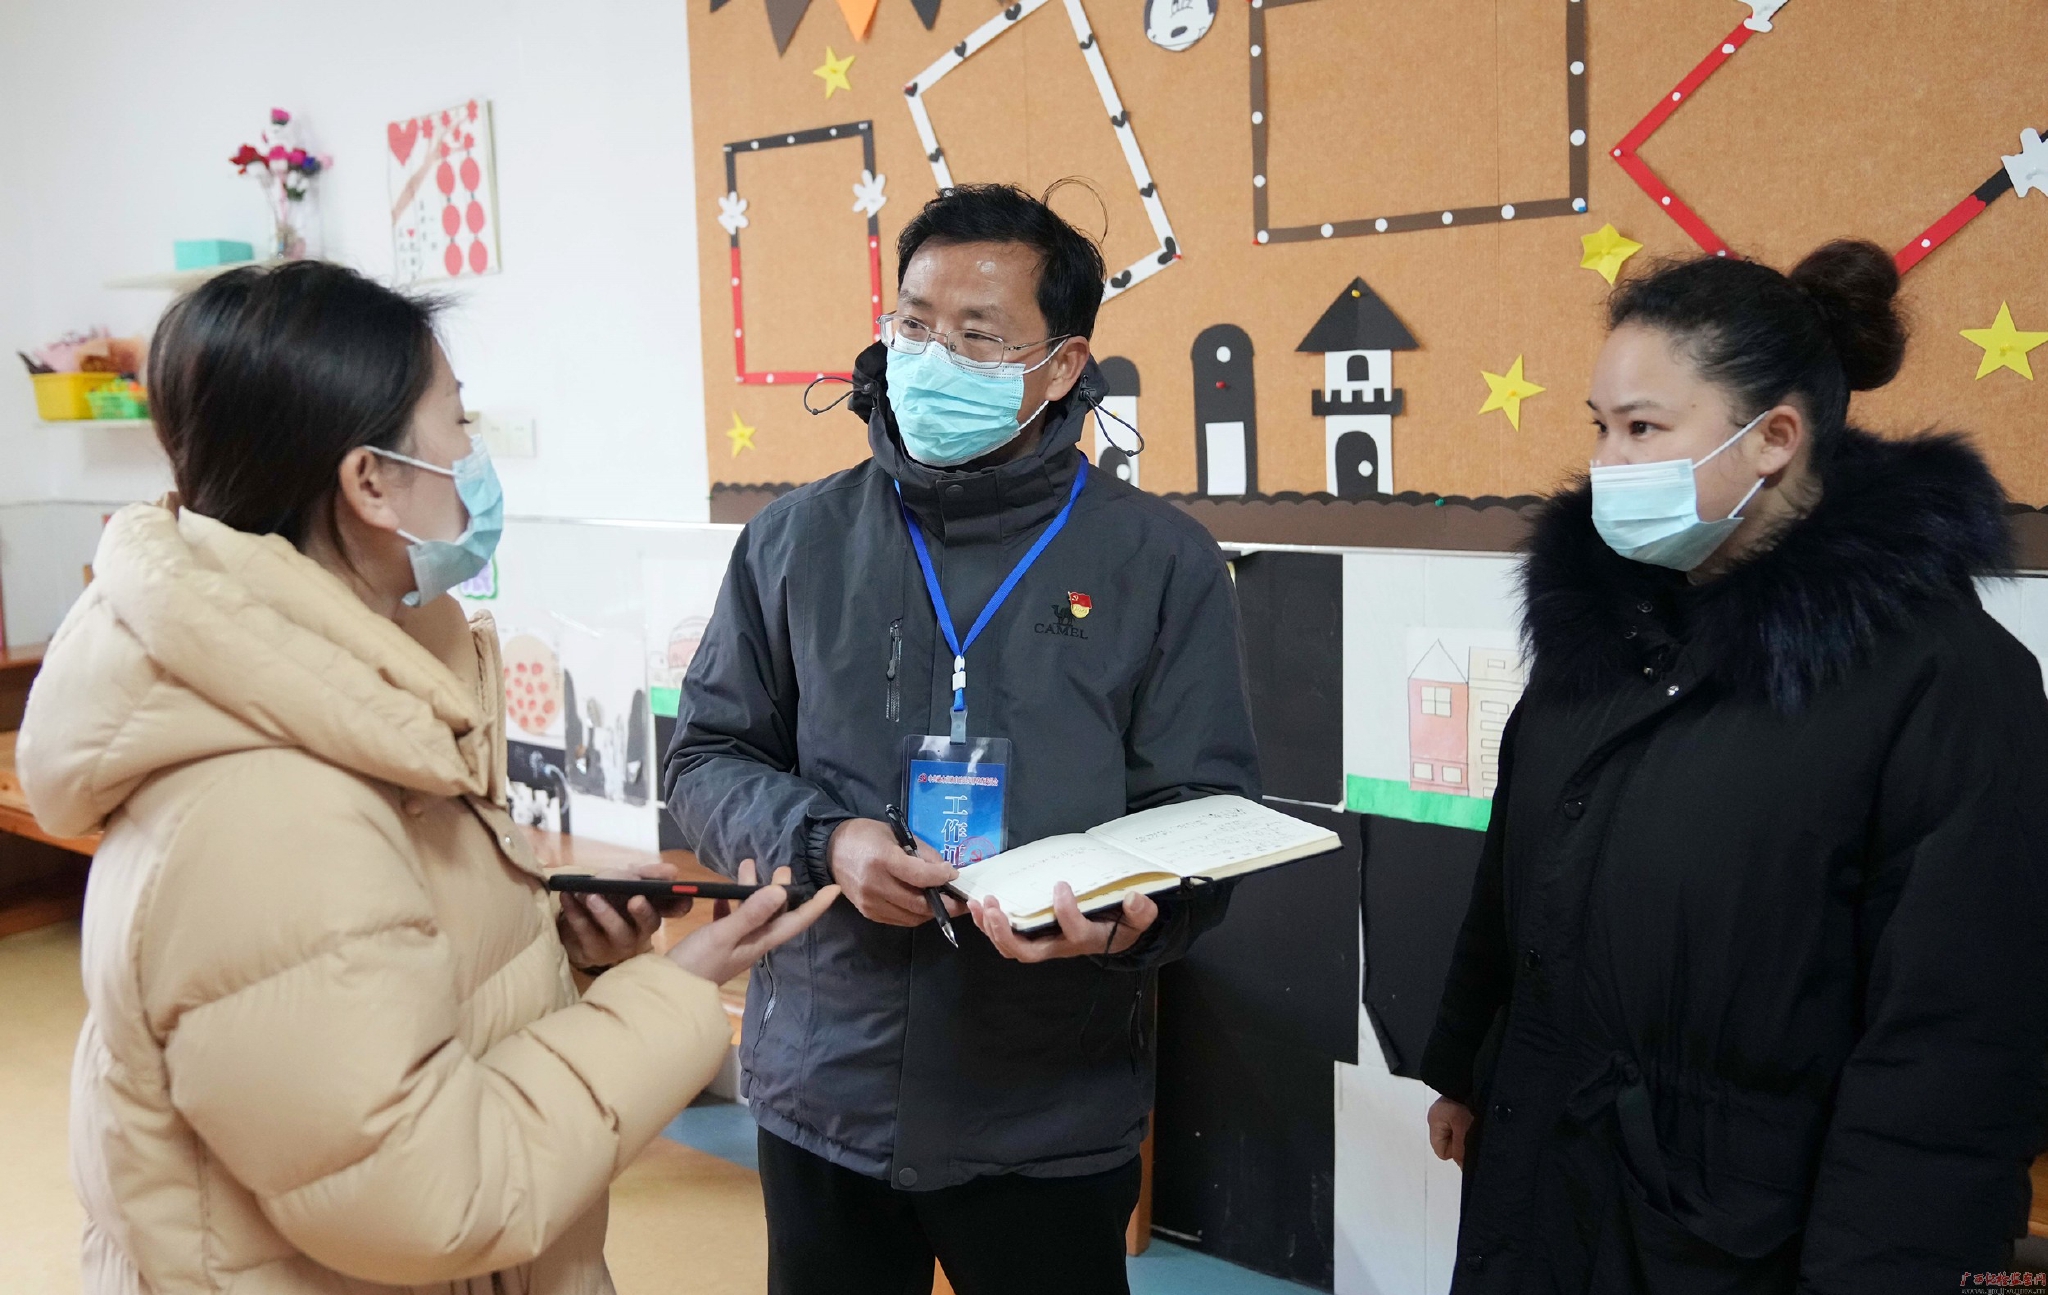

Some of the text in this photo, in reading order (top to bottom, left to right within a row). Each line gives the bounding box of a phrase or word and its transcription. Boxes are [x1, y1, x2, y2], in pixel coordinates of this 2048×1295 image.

[1034, 623, 1088, 639] CAMEL
[941, 794, 969, 866] 工作证
